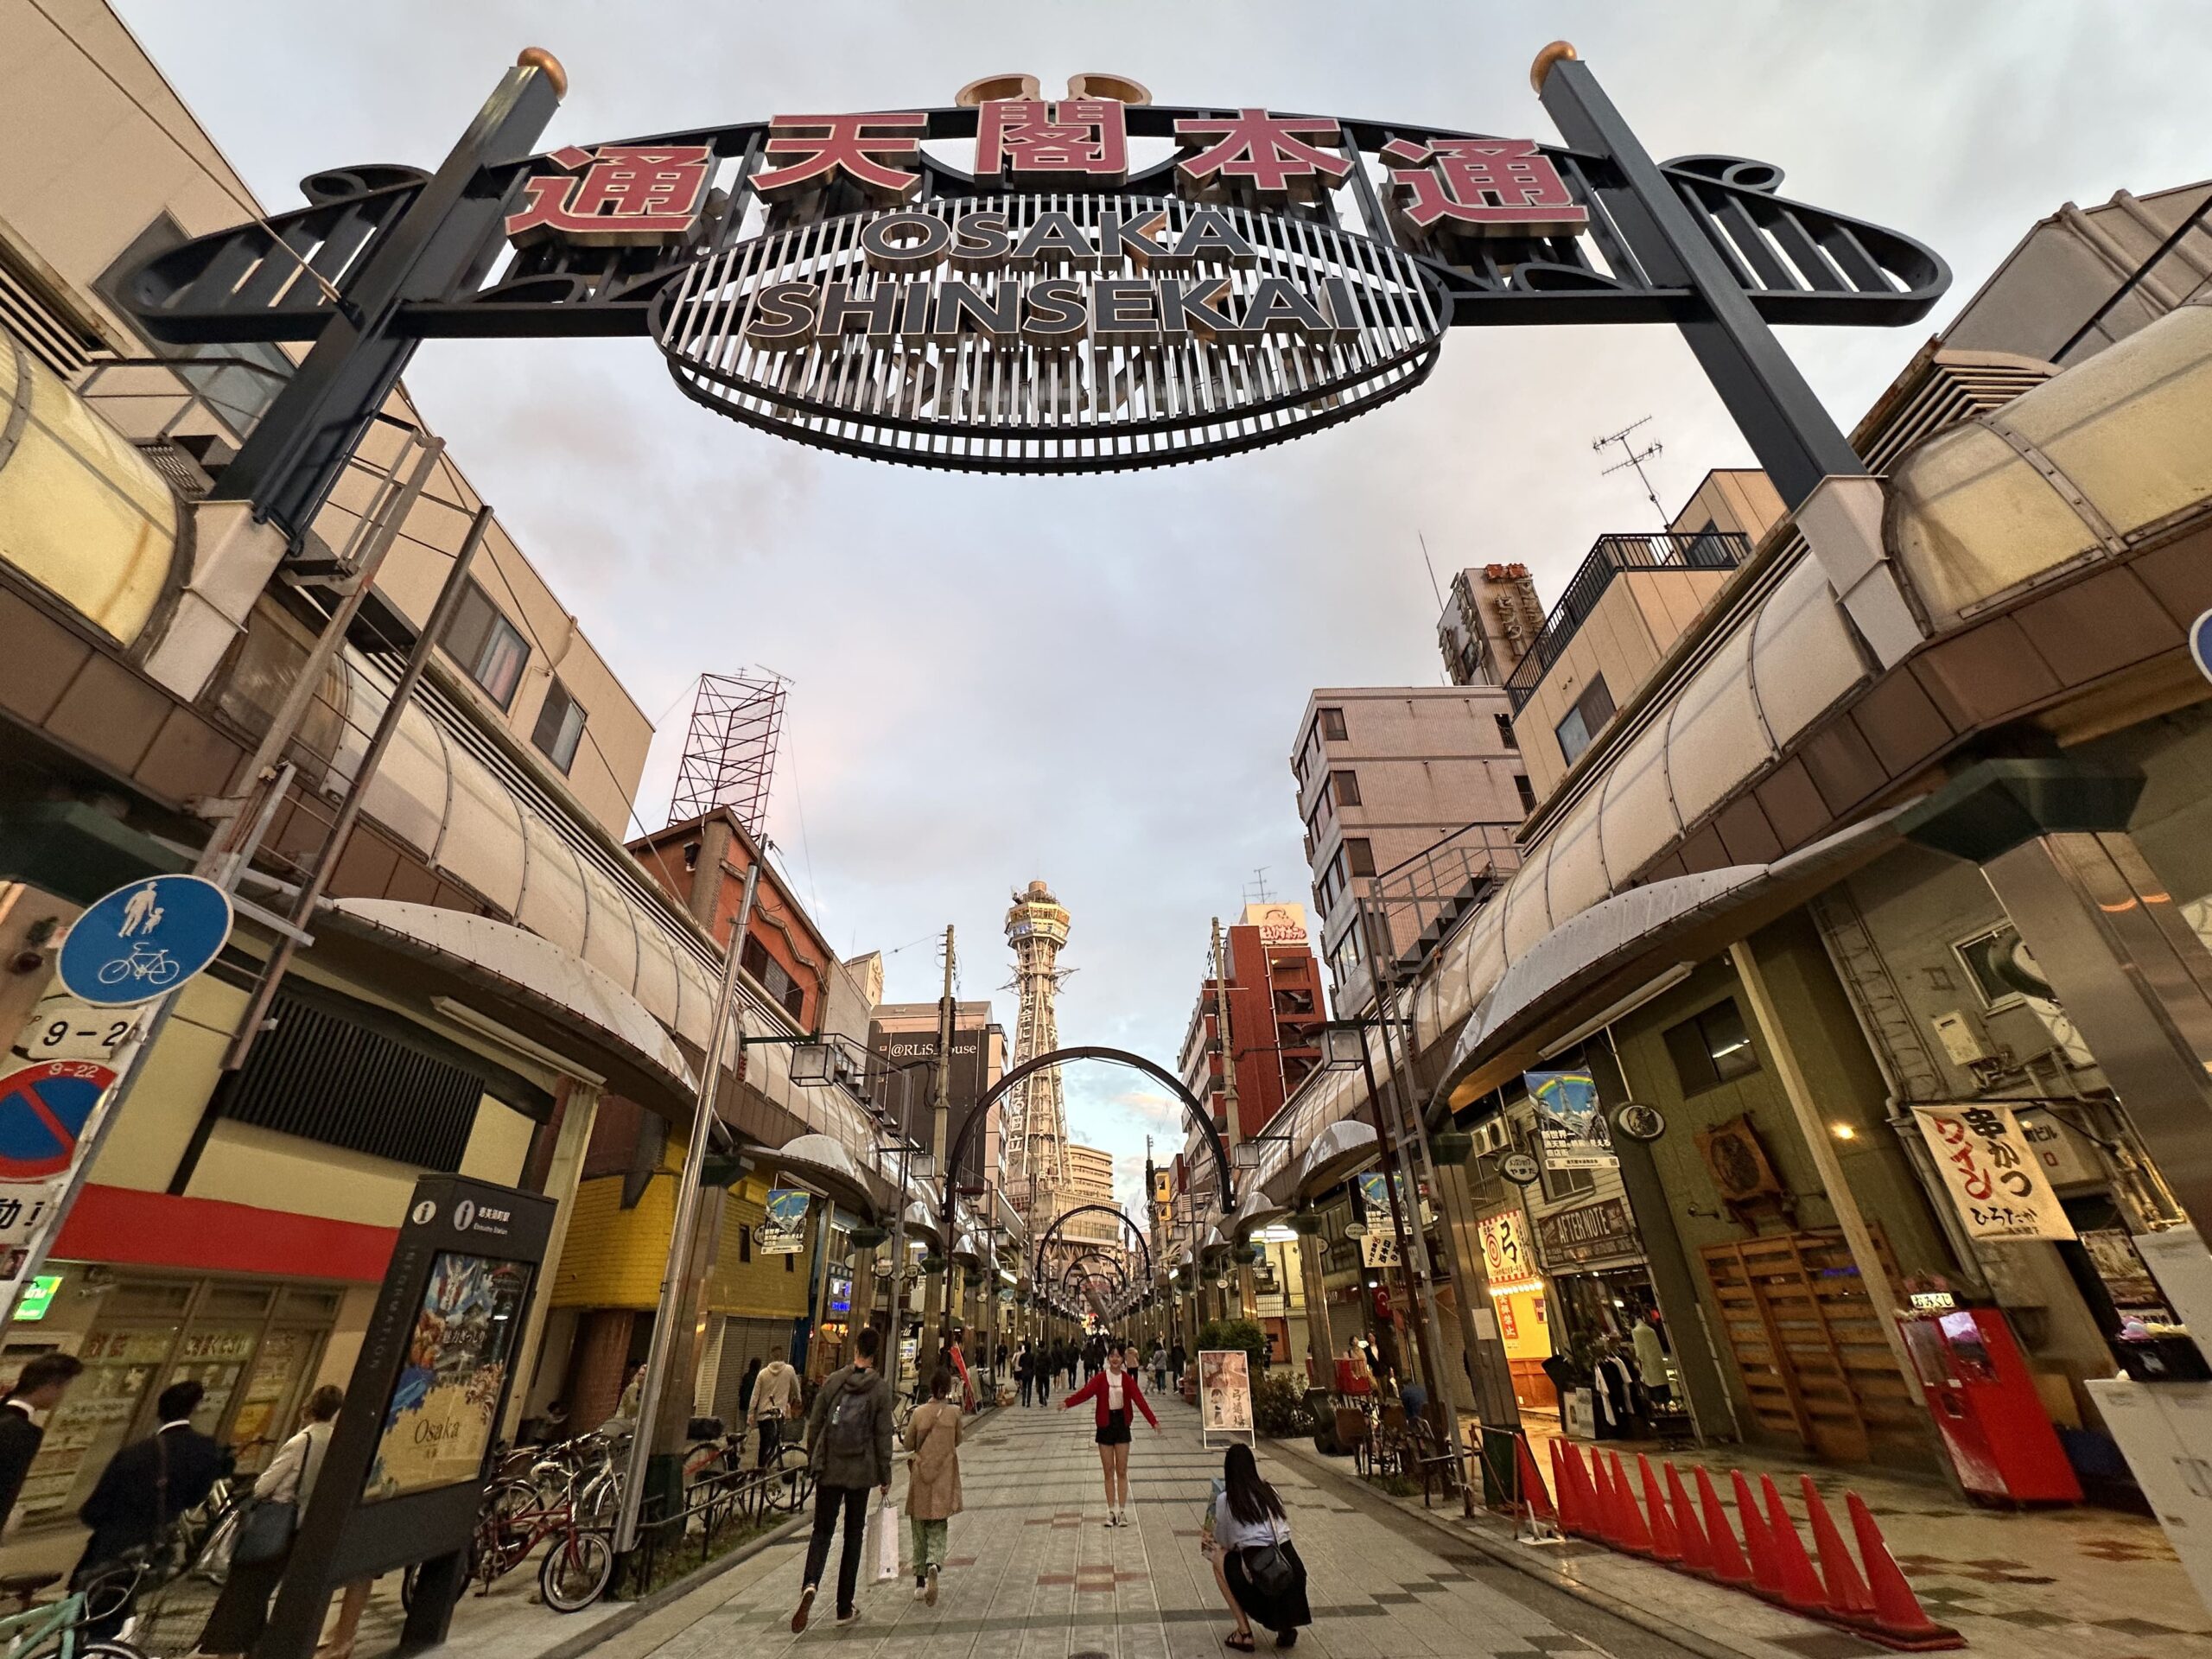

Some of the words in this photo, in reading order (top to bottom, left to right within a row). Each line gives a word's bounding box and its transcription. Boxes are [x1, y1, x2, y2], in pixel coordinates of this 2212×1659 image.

[505, 100, 1590, 238] 通天閣本通
[861, 211, 1257, 266] OSAKA
[745, 278, 1361, 344] SHINSEKAI
[48, 1062, 99, 1078] 9-22
[1008, 993, 1034, 1153] 社会に貢する日立
[1932, 1116, 1993, 1200] ワイン
[1961, 1107, 2033, 1198] 串かつ
[1500, 1220, 1517, 1263] 弓
[415, 1417, 461, 1444] Osaka
